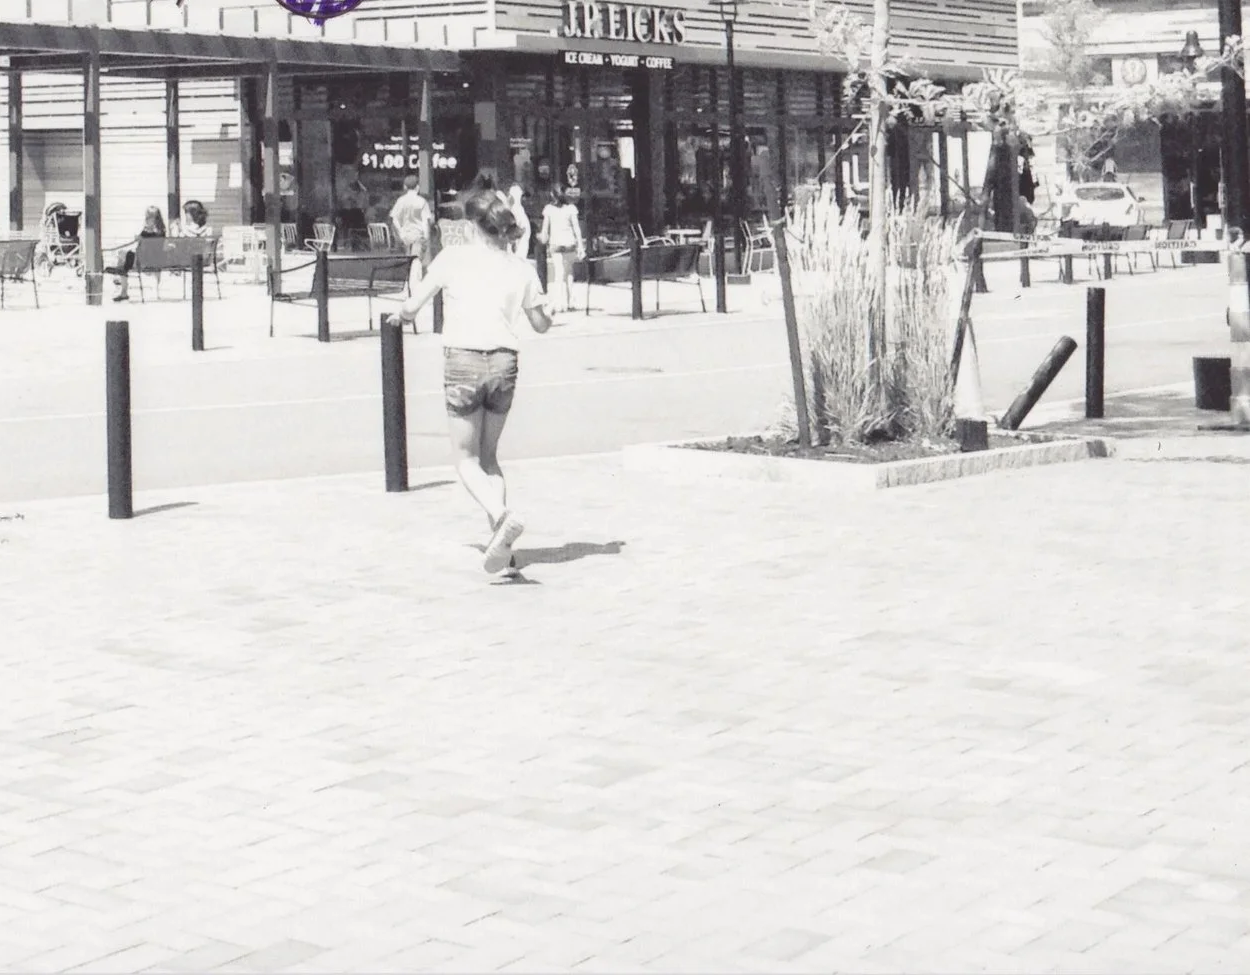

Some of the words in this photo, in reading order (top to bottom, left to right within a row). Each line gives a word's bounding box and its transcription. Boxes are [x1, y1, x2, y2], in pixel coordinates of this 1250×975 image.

[564, 0, 600, 38] J.P.
[607, 4, 687, 44] LICKS
[565, 51, 578, 64] ICE
[578, 53, 604, 65] CREAM
[646, 57, 673, 69] COFFEE
[362, 153, 404, 169] $1.00
[409, 153, 457, 169] Cfee
